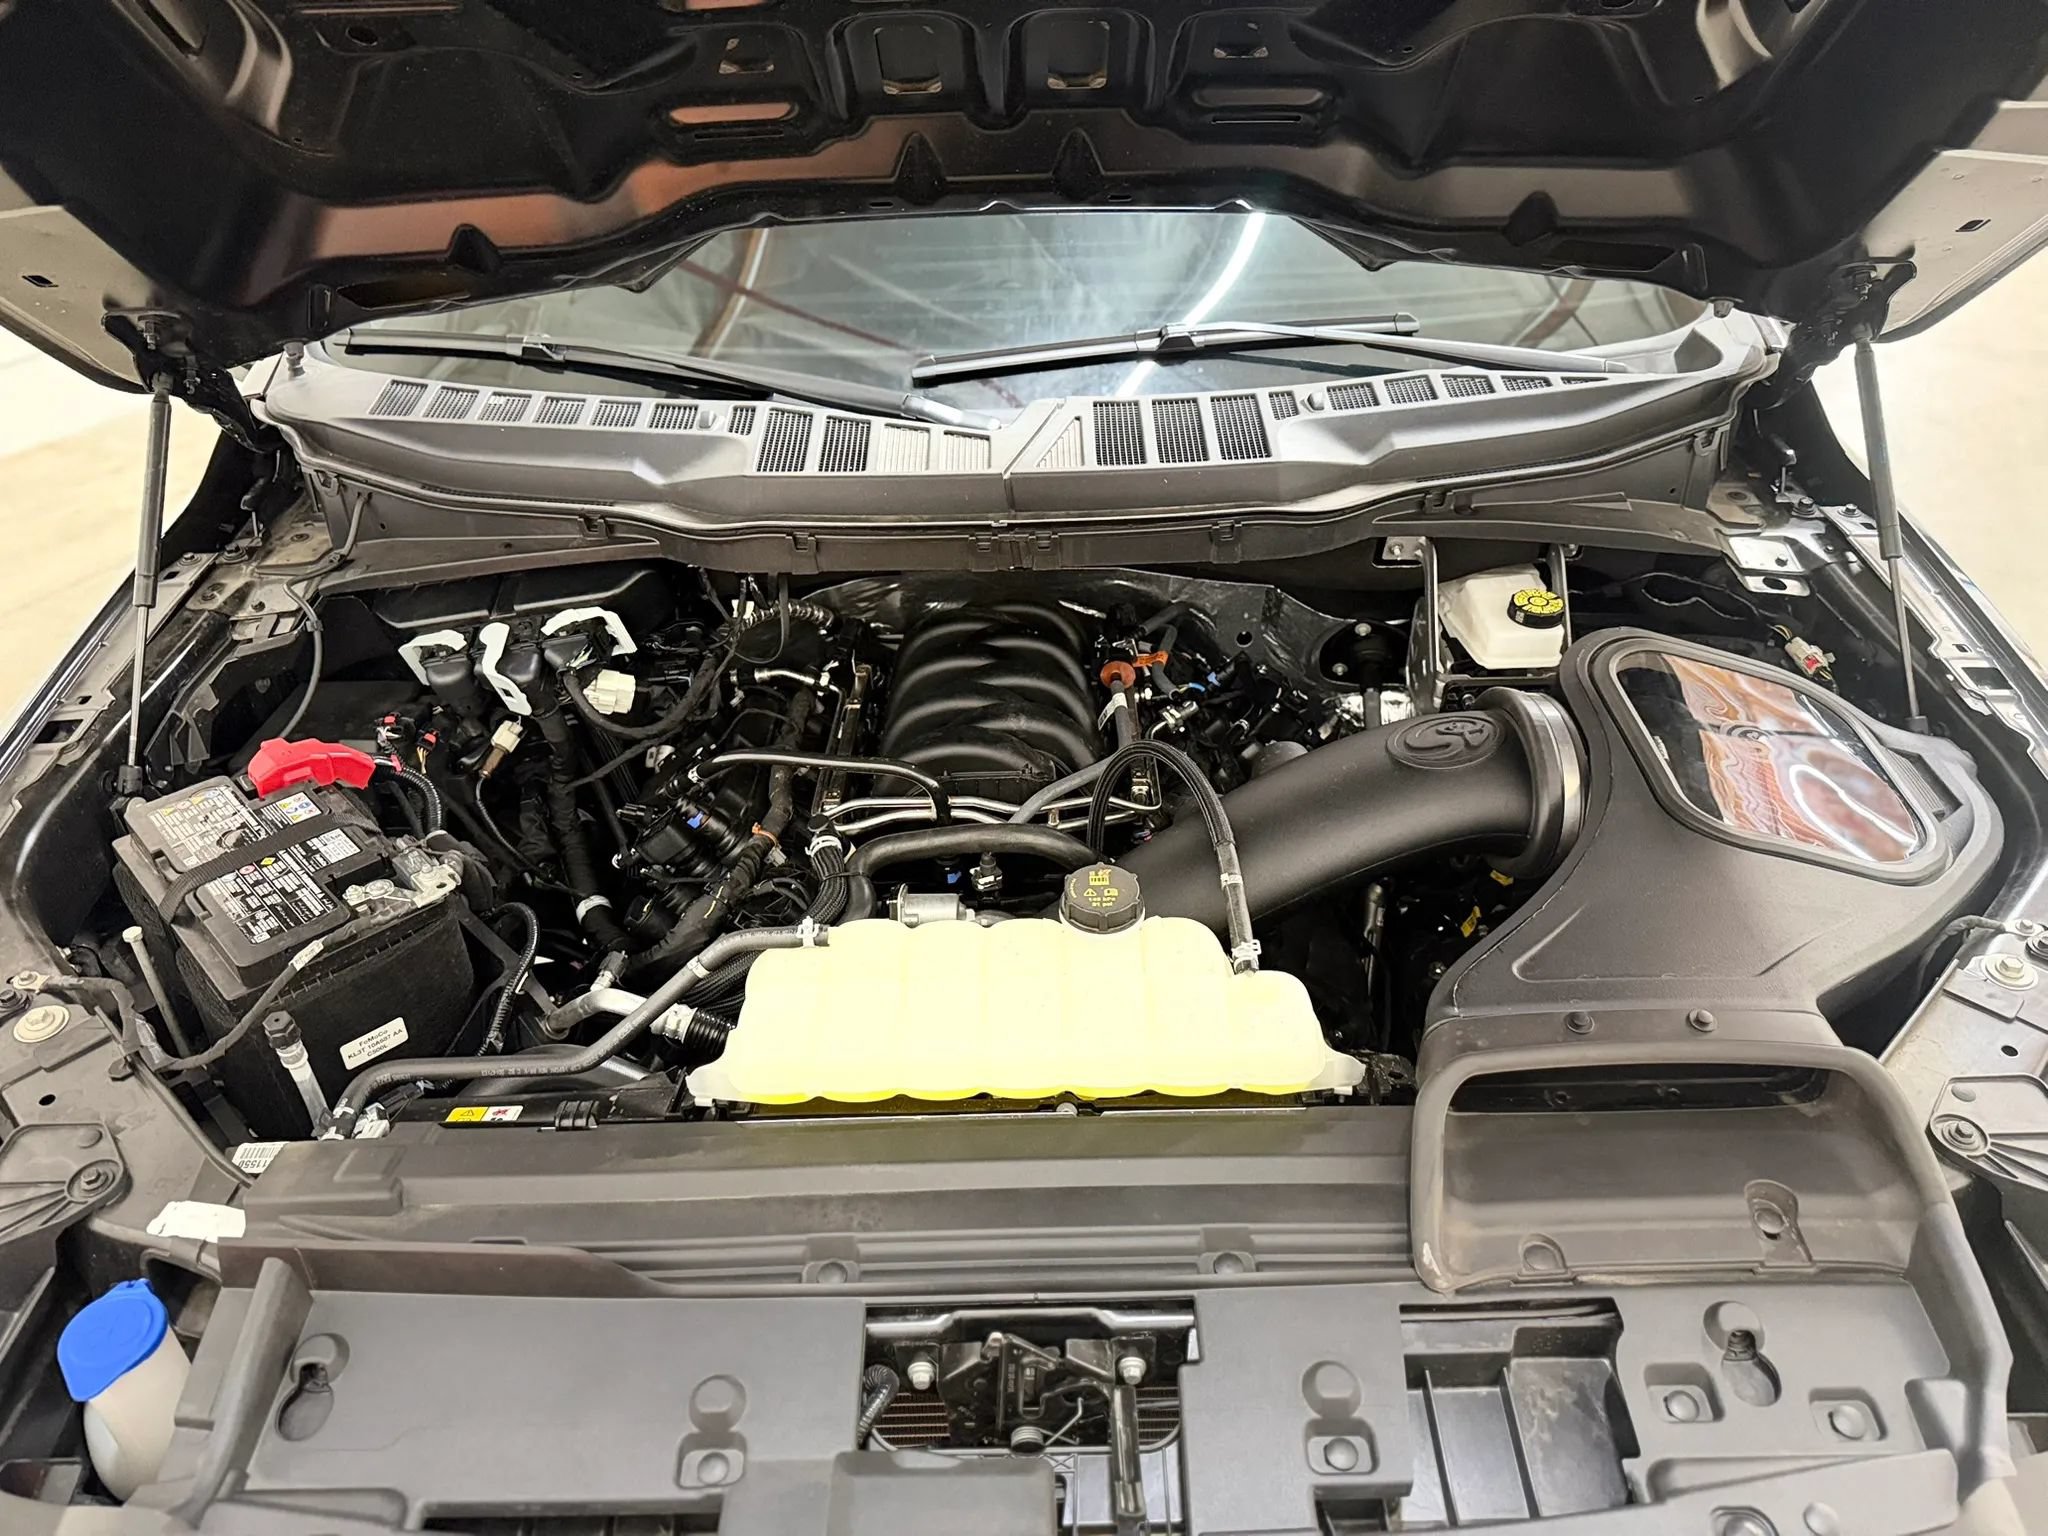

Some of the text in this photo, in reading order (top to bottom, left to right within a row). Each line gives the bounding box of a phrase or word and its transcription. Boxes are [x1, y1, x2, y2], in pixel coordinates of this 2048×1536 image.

[347, 1047, 366, 1060] KL3T
[392, 1028, 403, 1037] AA
[358, 1029, 389, 1047] FoMoCo
